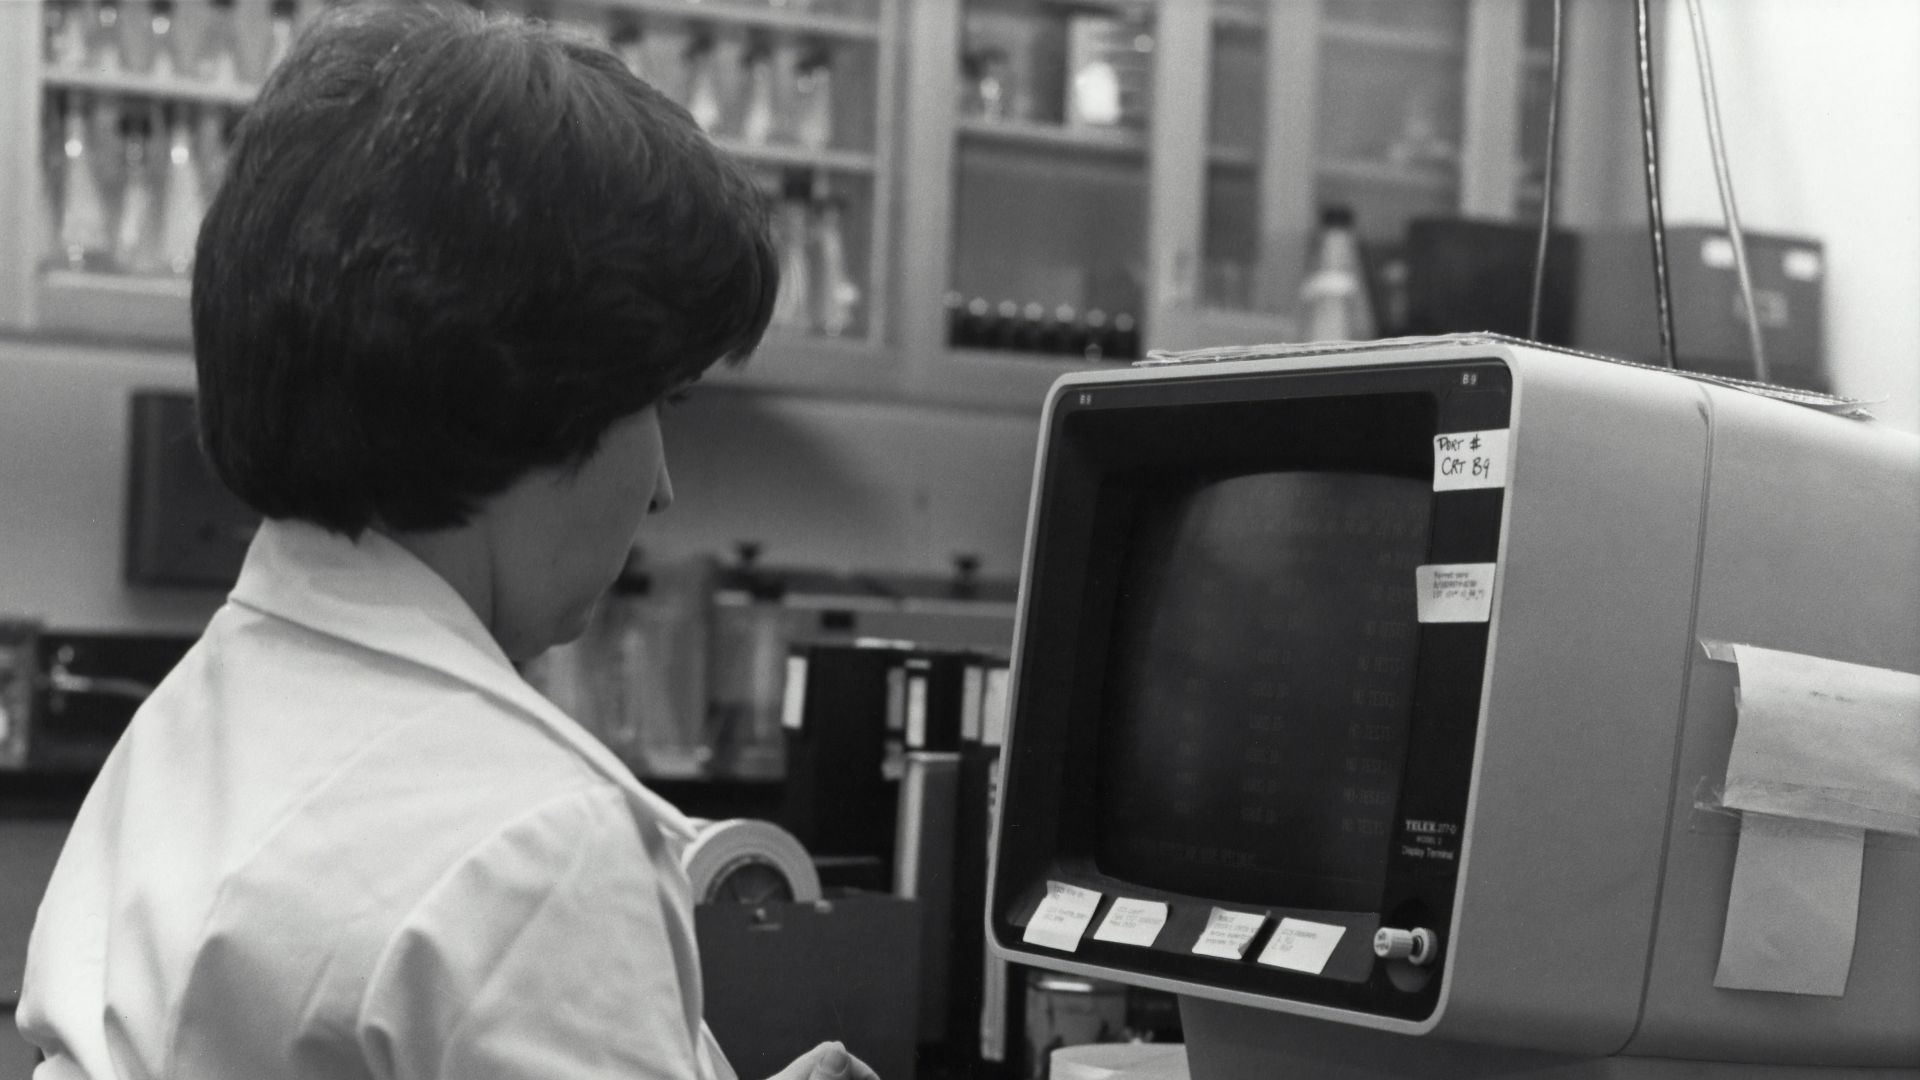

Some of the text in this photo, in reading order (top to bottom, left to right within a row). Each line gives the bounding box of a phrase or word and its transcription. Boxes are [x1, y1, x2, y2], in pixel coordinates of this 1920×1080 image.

[1470, 433, 1482, 452] #
[1441, 456, 1490, 479] CRT B9
[1405, 819, 1436, 833] TELEX
[1426, 847, 1454, 861] Terminal
